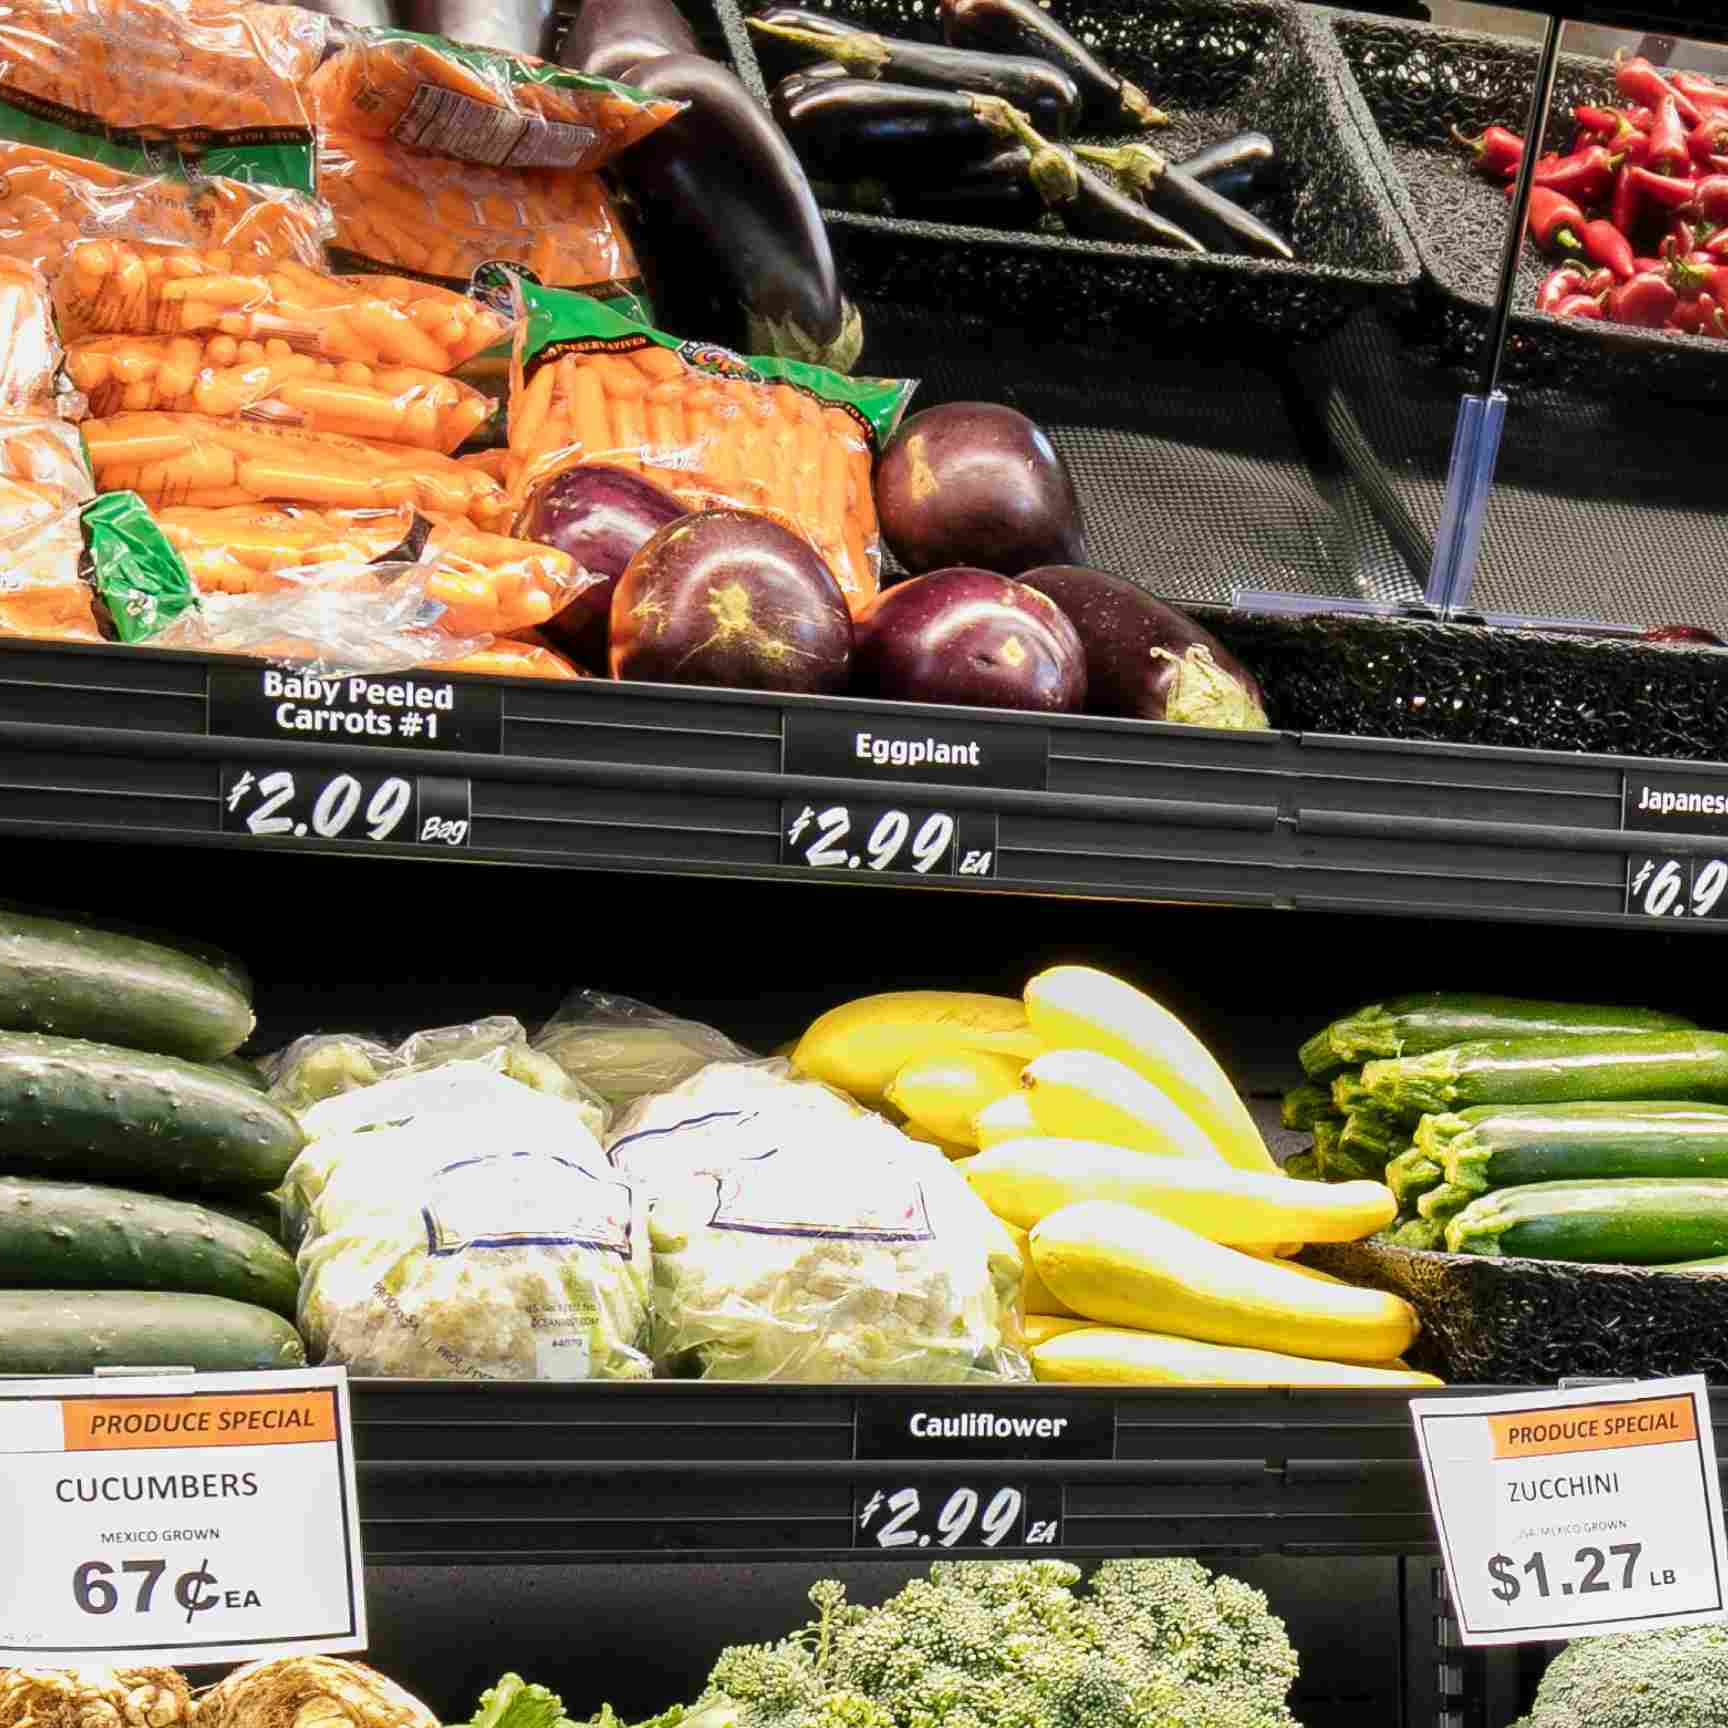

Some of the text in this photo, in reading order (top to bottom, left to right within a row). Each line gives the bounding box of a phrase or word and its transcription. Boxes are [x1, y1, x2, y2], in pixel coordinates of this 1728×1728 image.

[264, 671, 453, 711] Baby Peeled
[277, 703, 437, 738] Carrots #1
[856, 733, 980, 765] Eggplant
[226, 771, 411, 840] $2.09
[788, 806, 953, 873] $2.99
[91, 1409, 314, 1434] PRODUCE SPECIAL
[910, 1413, 1067, 1437] Cauliflower
[1510, 1412, 1678, 1444] PRODUCE SPECIAL
[56, 1473, 257, 1502] CUCUMBERS
[1508, 1472, 1618, 1502] ZUCCHINI
[860, 1488, 1021, 1548] $2.99
[101, 1528, 220, 1543] MEXICO GROWN
[1488, 1543, 1641, 1605] $1.27
[73, 1559, 261, 1624] 67¢ EA
